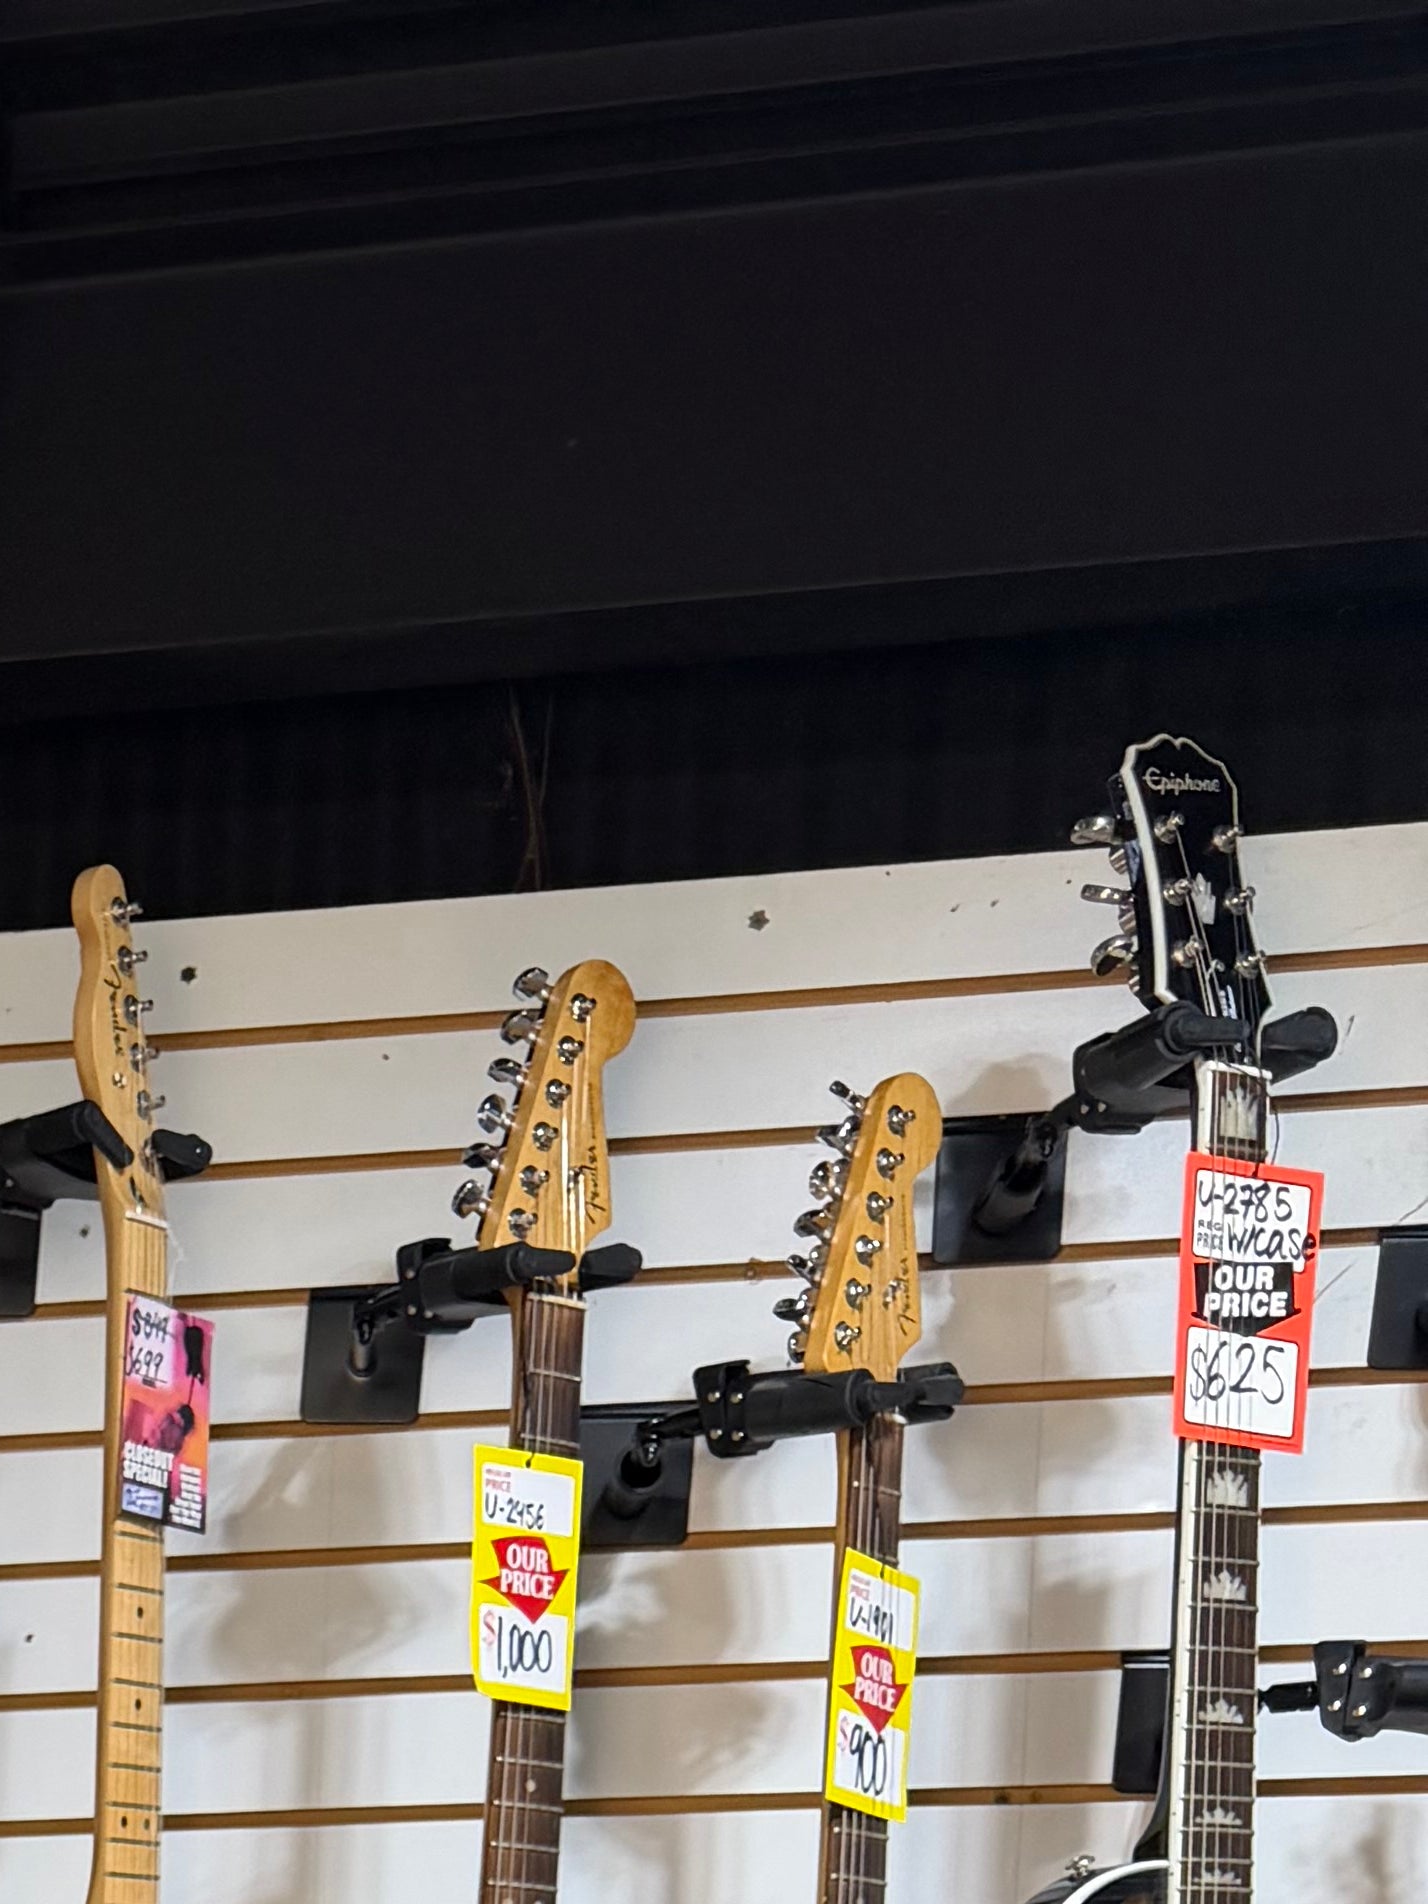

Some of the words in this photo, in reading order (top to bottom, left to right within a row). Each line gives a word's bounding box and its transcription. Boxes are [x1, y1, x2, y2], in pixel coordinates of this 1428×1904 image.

[1144, 766, 1221, 796] Epiphone
[103, 962, 129, 1058] Fender
[1198, 1180, 1293, 1224] U-2785
[1214, 1264, 1275, 1292] OUR
[1202, 1290, 1290, 1319] PRICE
[1189, 1340, 1285, 1406] $625
[484, 1477, 512, 1493] PRICE
[505, 1543, 549, 1573] OUR
[499, 1568, 555, 1600] PRICE
[482, 1610, 553, 1679] $1,000
[860, 1651, 894, 1686] OUR
[854, 1675, 896, 1713] PRICE
